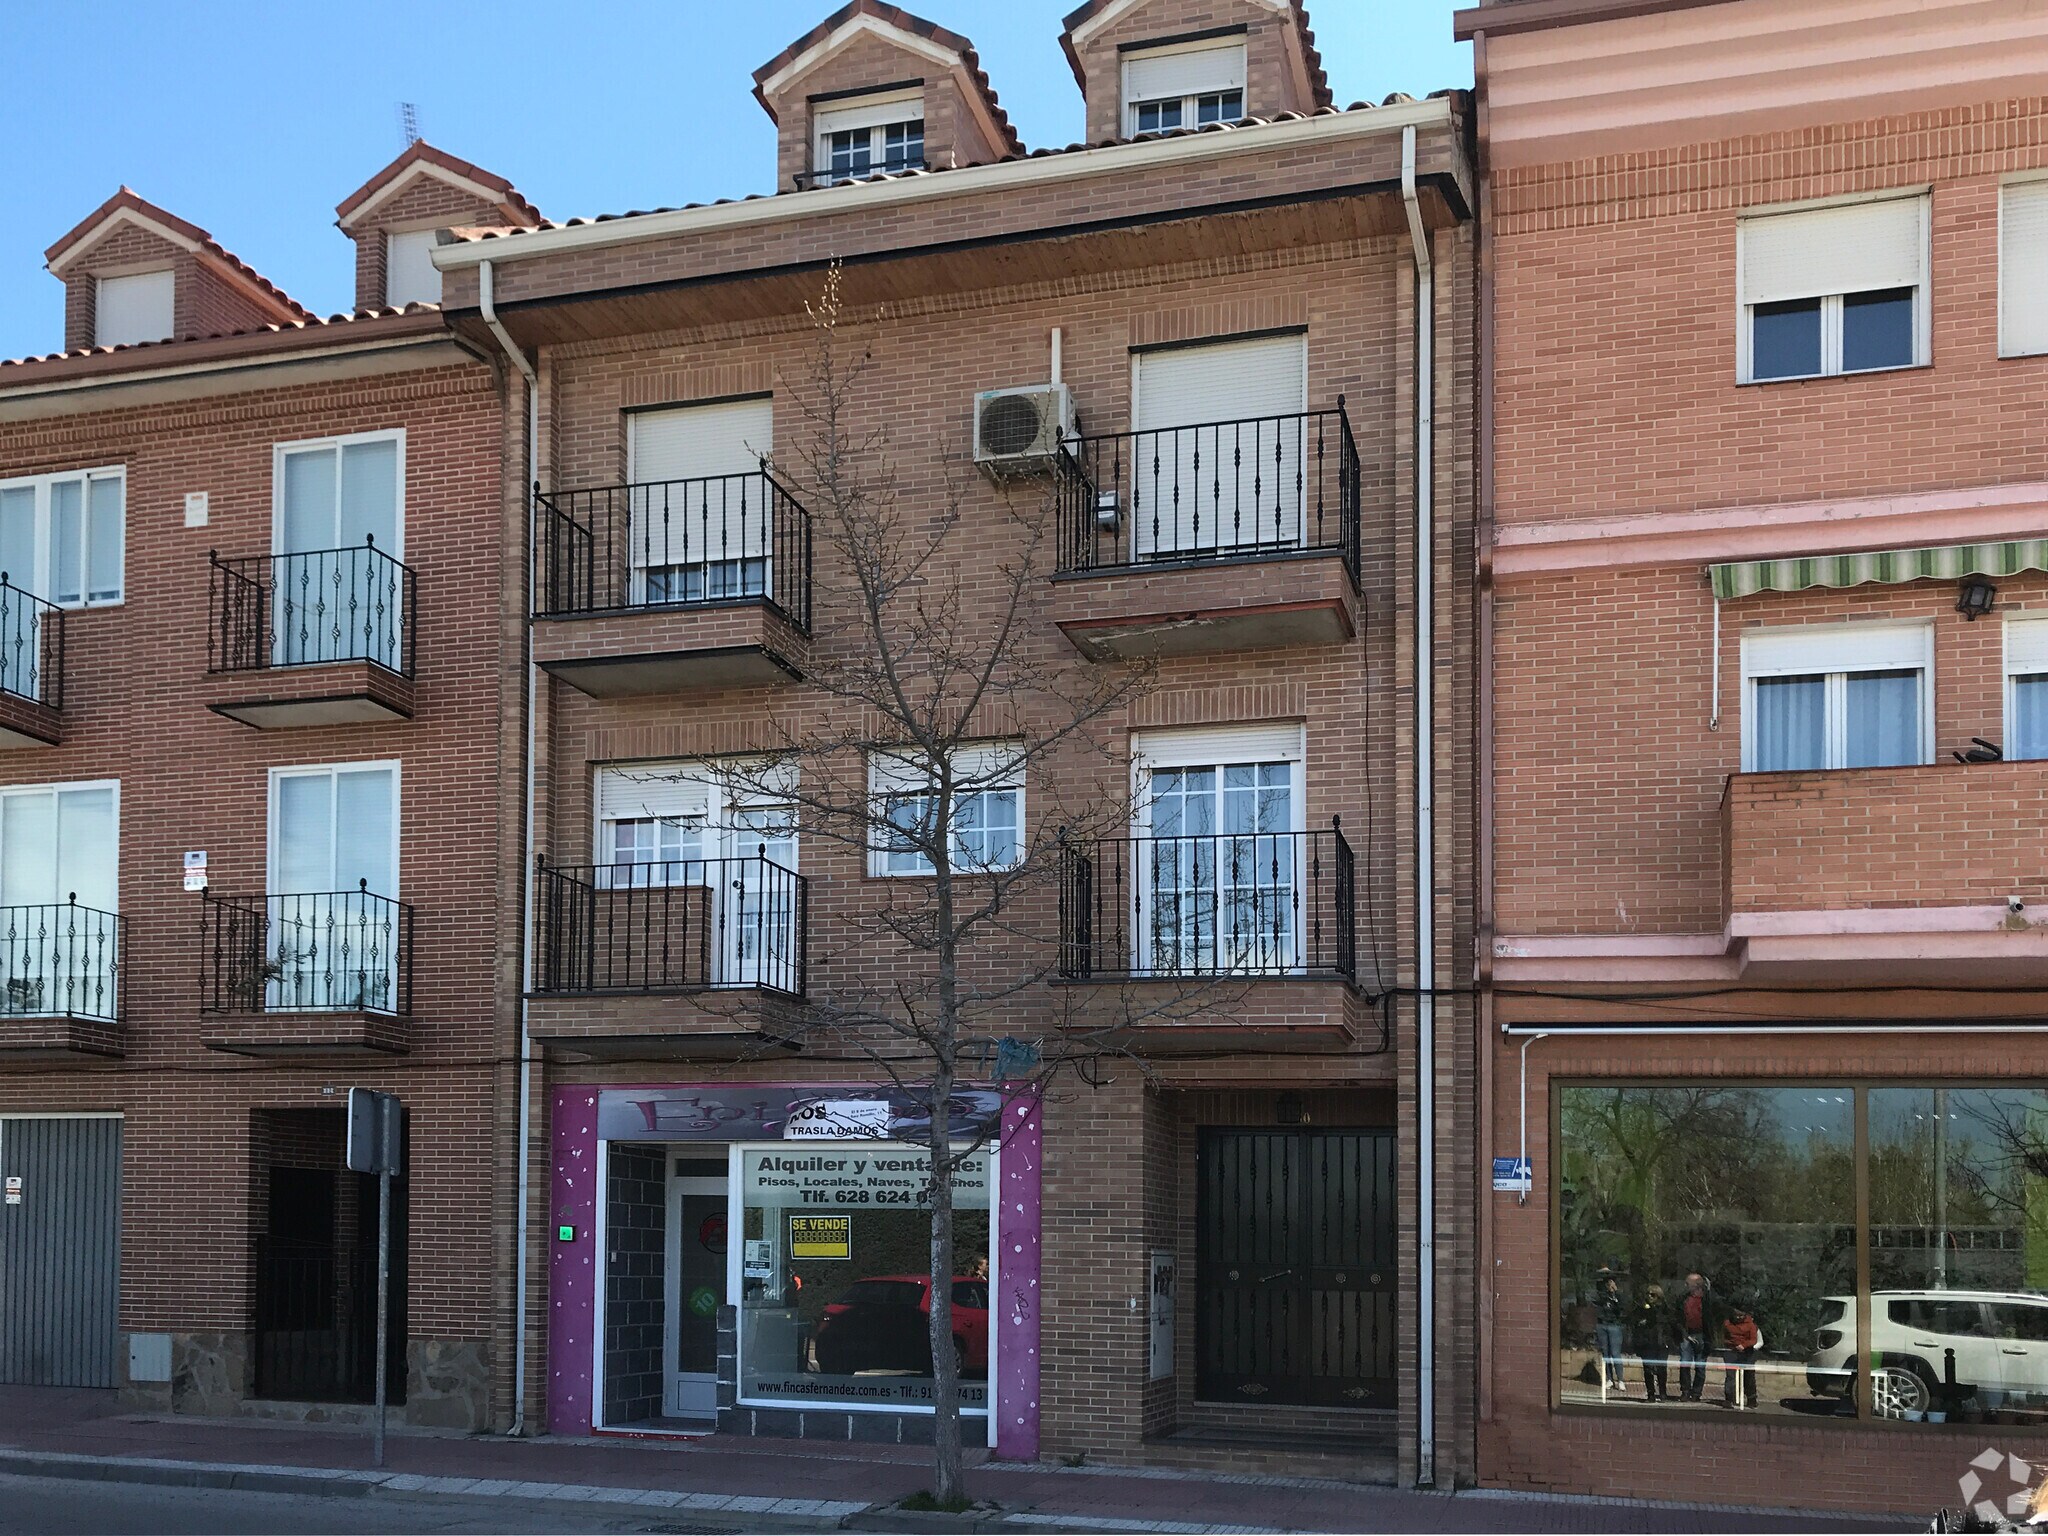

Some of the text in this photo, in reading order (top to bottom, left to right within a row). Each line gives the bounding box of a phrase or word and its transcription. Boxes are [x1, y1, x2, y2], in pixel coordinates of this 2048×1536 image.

[758, 1157, 847, 1174] Alquiler
[854, 1161, 867, 1174] y
[758, 1177, 984, 1188] Pisos, Locales, Naves, Tenos
[800, 1190, 830, 1203] Tlf.
[835, 1190, 870, 1203] 628
[875, 1190, 911, 1203] 624
[792, 1219, 848, 1230] SE VENDE
[757, 1381, 891, 1397] www.fincasfernandez.com.es
[900, 1386, 918, 1398] Tlf.:
[921, 1387, 933, 1399] 91
[971, 1389, 983, 1401] 13
